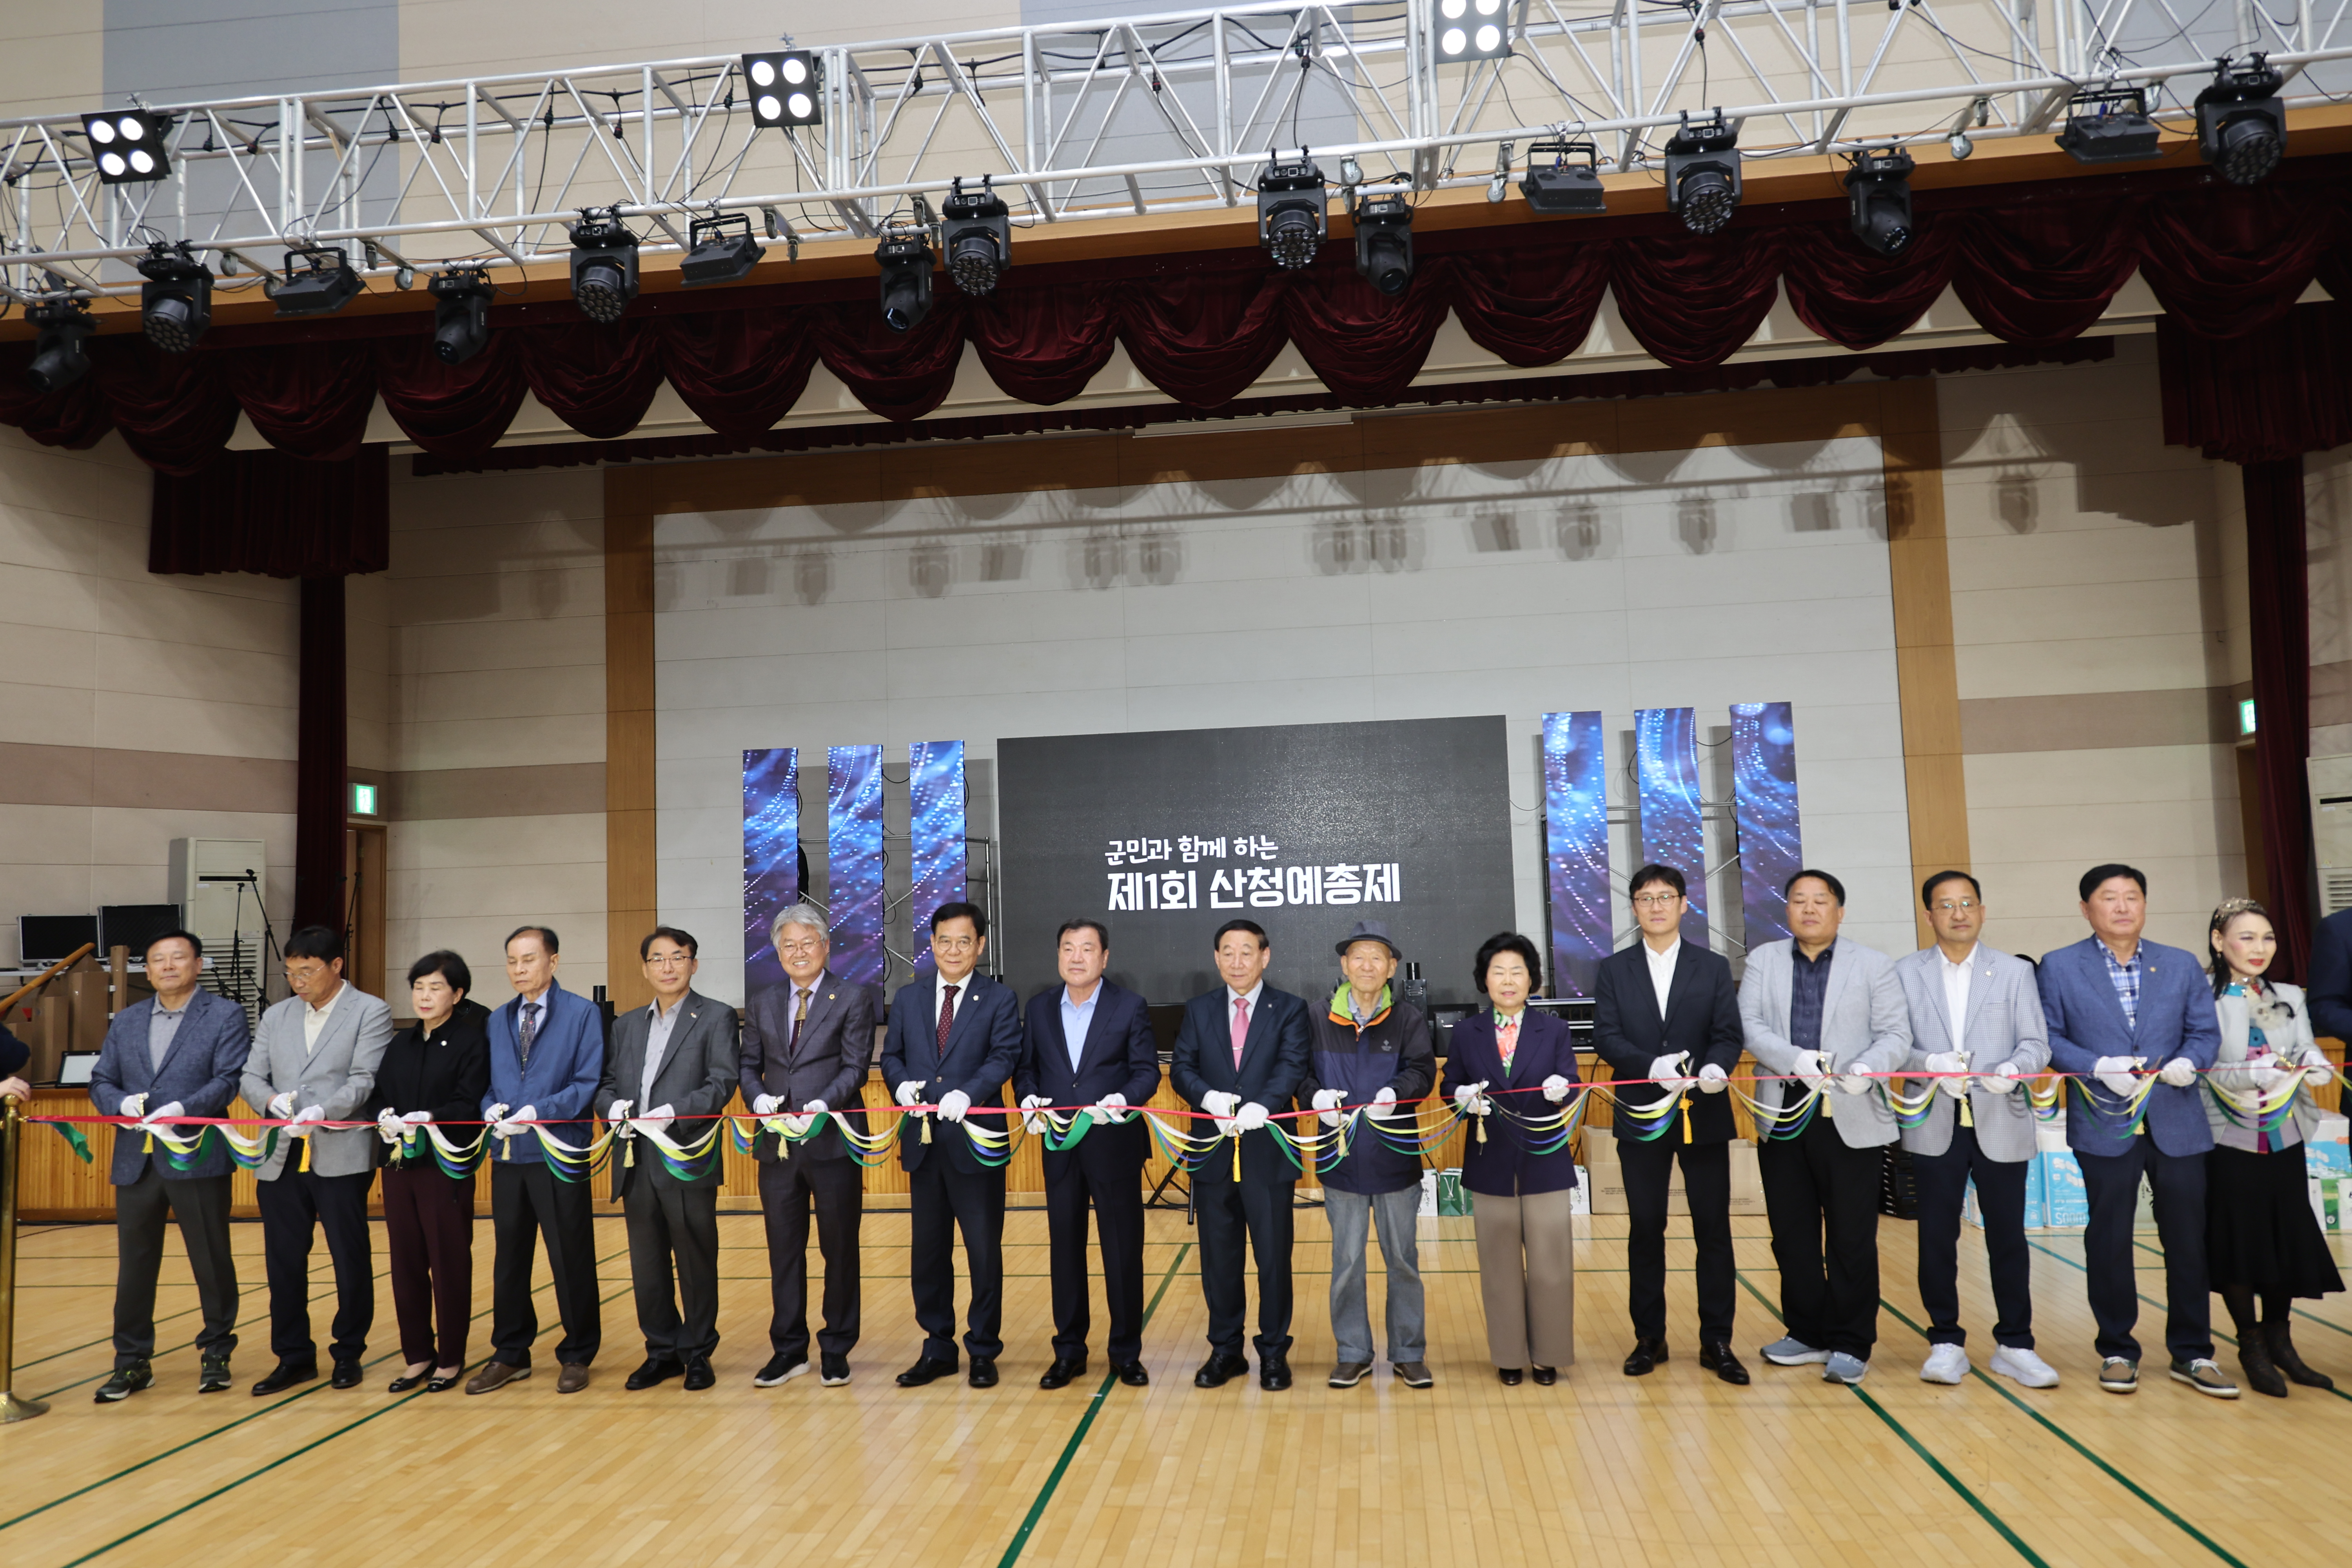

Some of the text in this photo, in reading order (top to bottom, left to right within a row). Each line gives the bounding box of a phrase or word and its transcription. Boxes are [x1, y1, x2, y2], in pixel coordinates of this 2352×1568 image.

[1105, 835, 1279, 866] 군민과 함께 하는
[1107, 863, 1400, 911] 제1회 산청예총제
